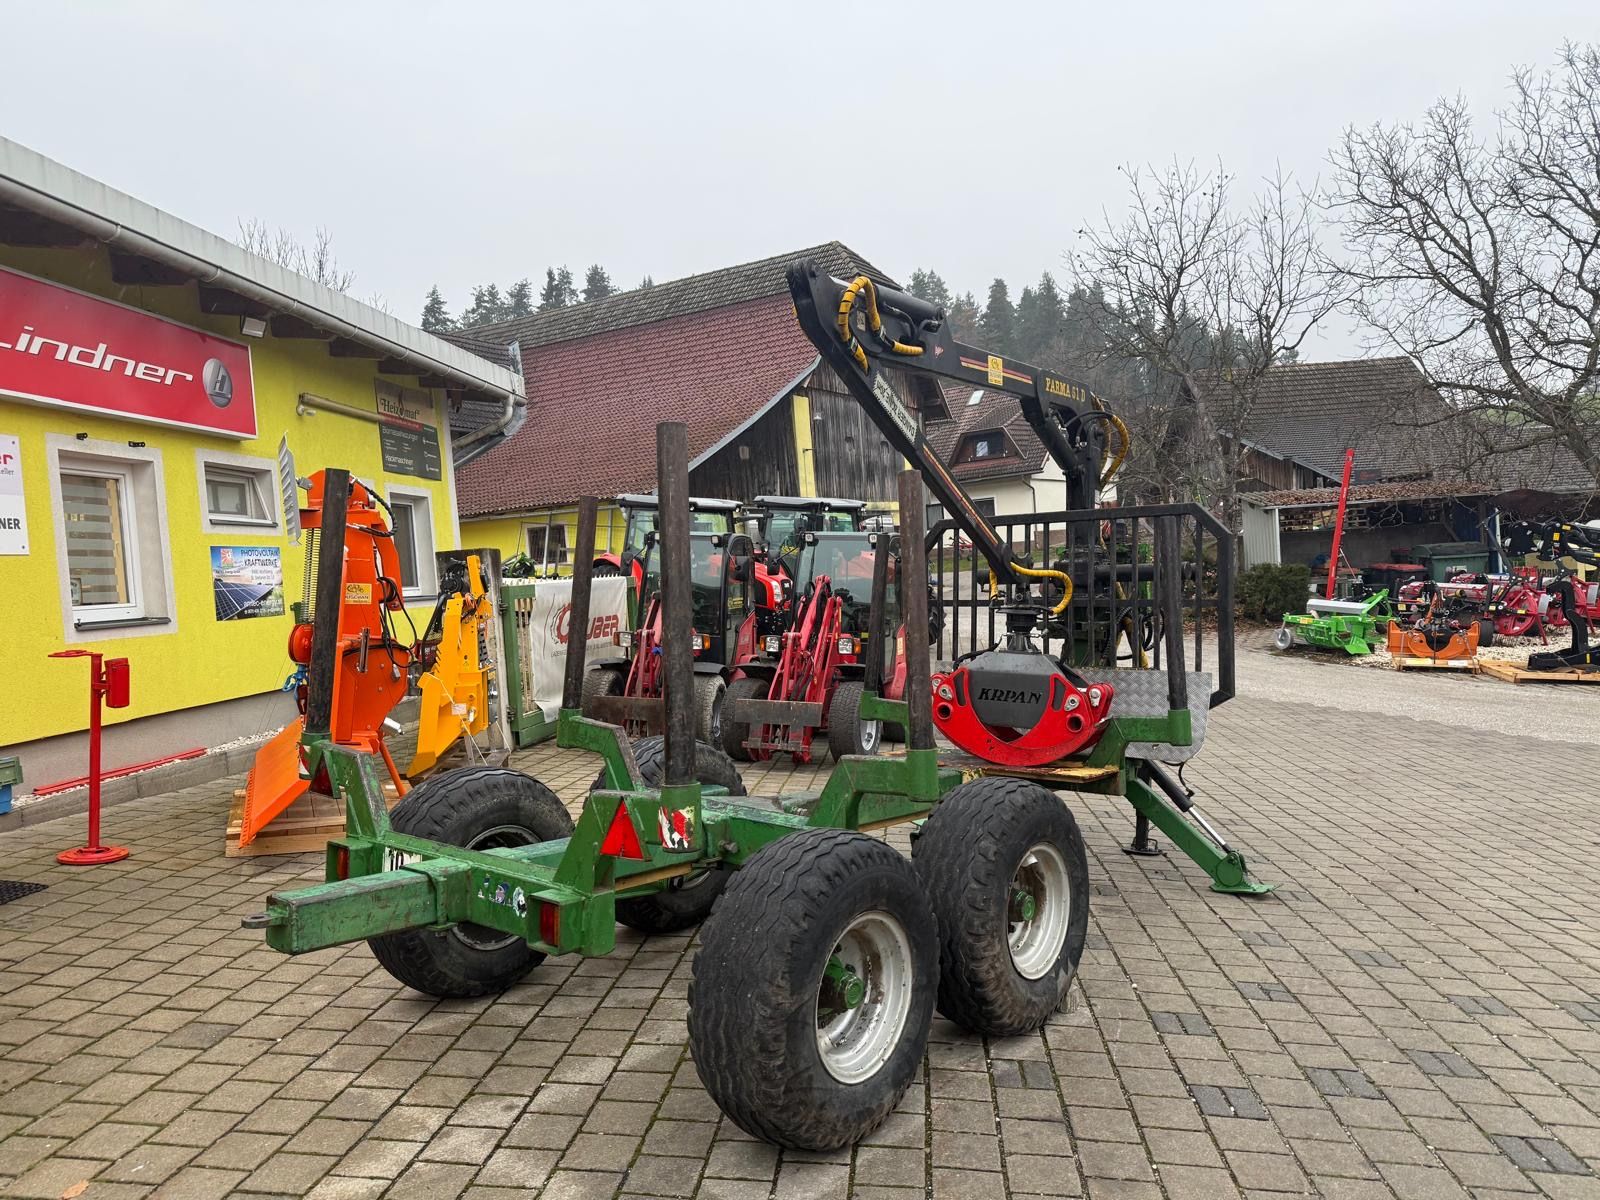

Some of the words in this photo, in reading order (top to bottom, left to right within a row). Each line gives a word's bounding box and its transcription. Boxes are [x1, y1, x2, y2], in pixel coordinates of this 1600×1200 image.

[241, 549, 279, 557] PHOTOVOLTAIK
[244, 559, 278, 567] KRAFTWERKE
[978, 687, 1042, 704] KRPAN
